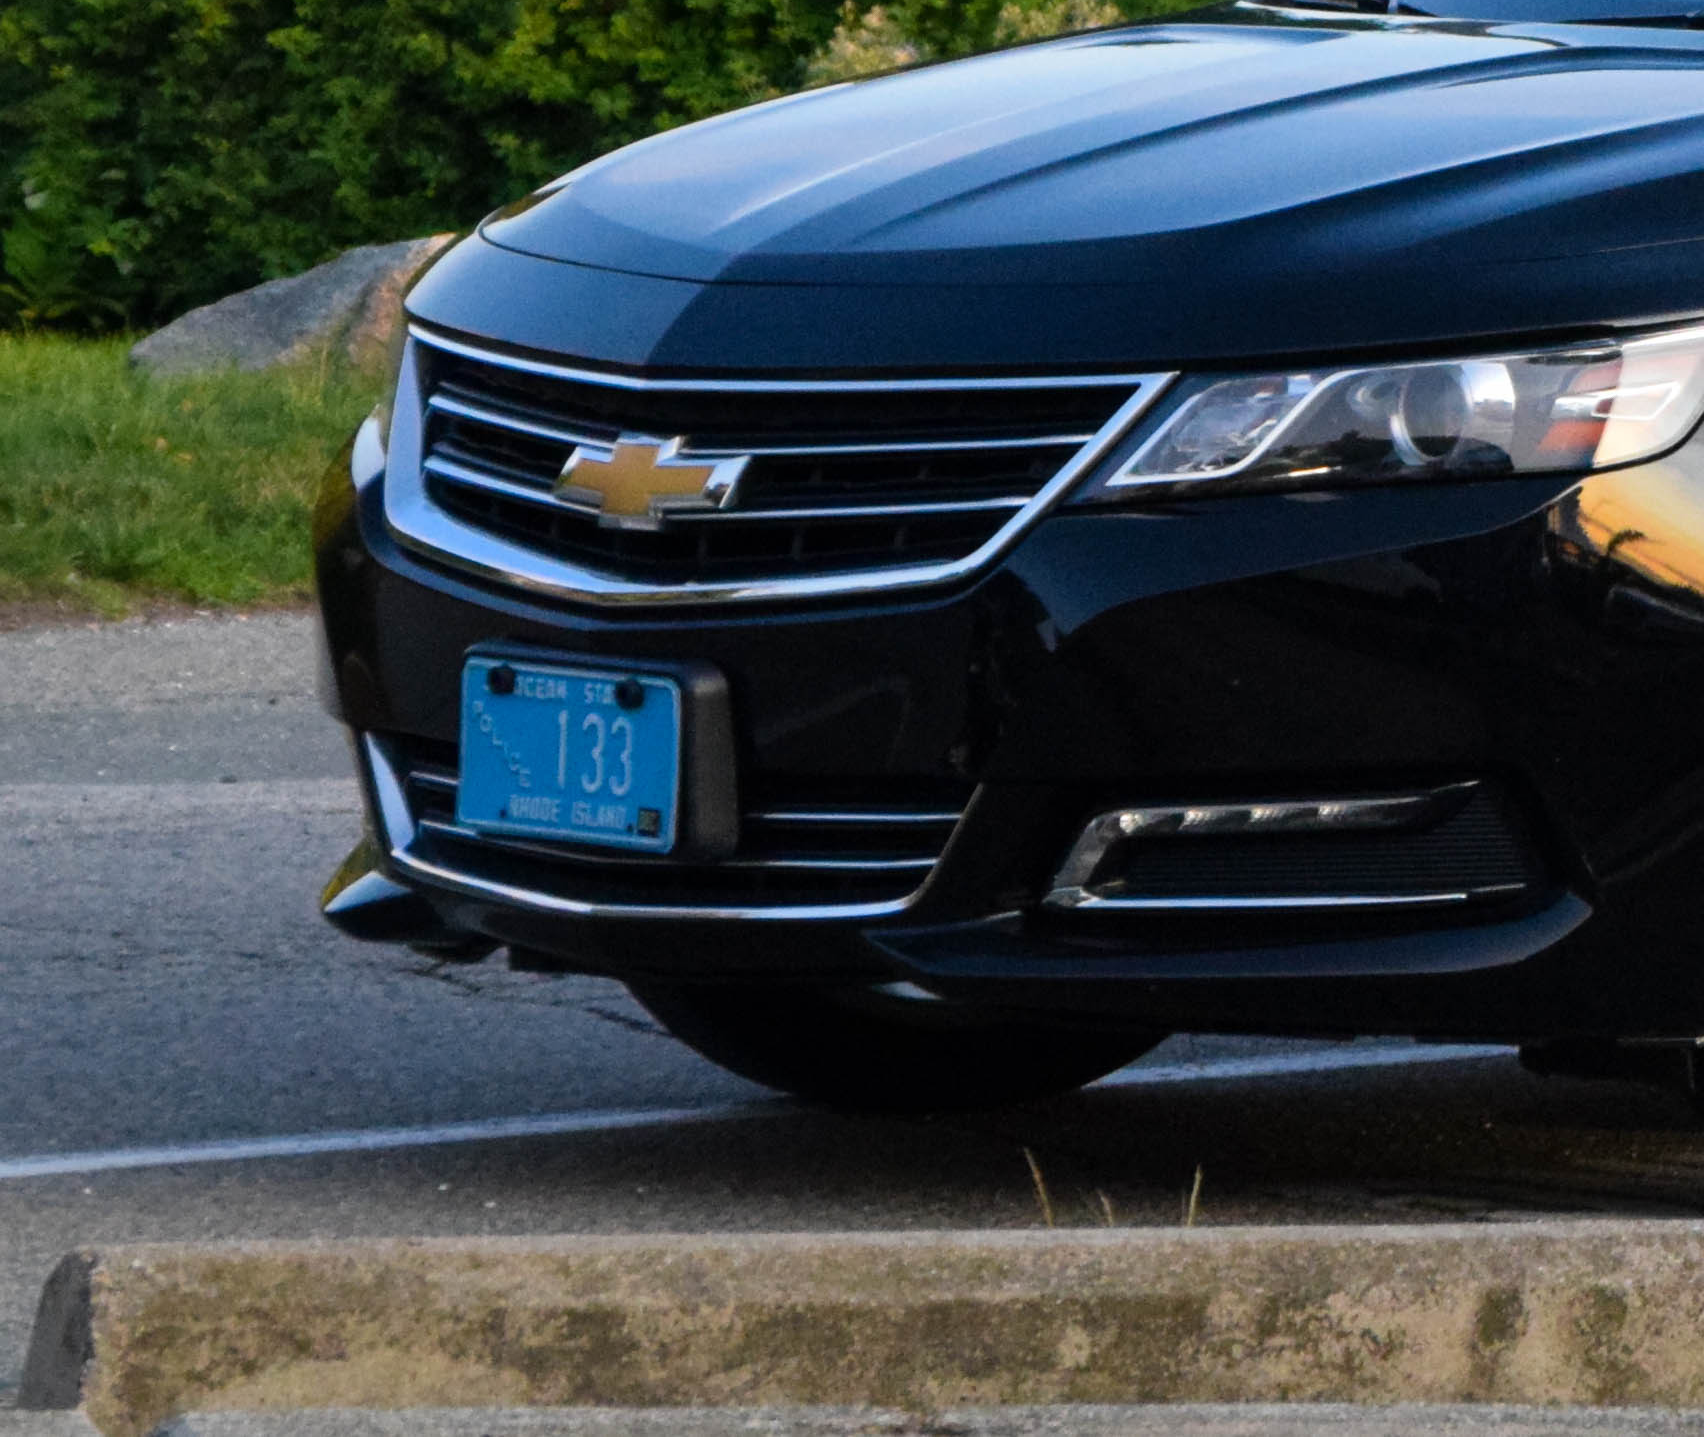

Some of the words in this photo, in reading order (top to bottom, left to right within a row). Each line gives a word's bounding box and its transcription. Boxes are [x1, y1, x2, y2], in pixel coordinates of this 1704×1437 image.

[556, 709, 634, 798] 133
[509, 794, 561, 824] RHODE
[571, 801, 627, 830] ISLAND
